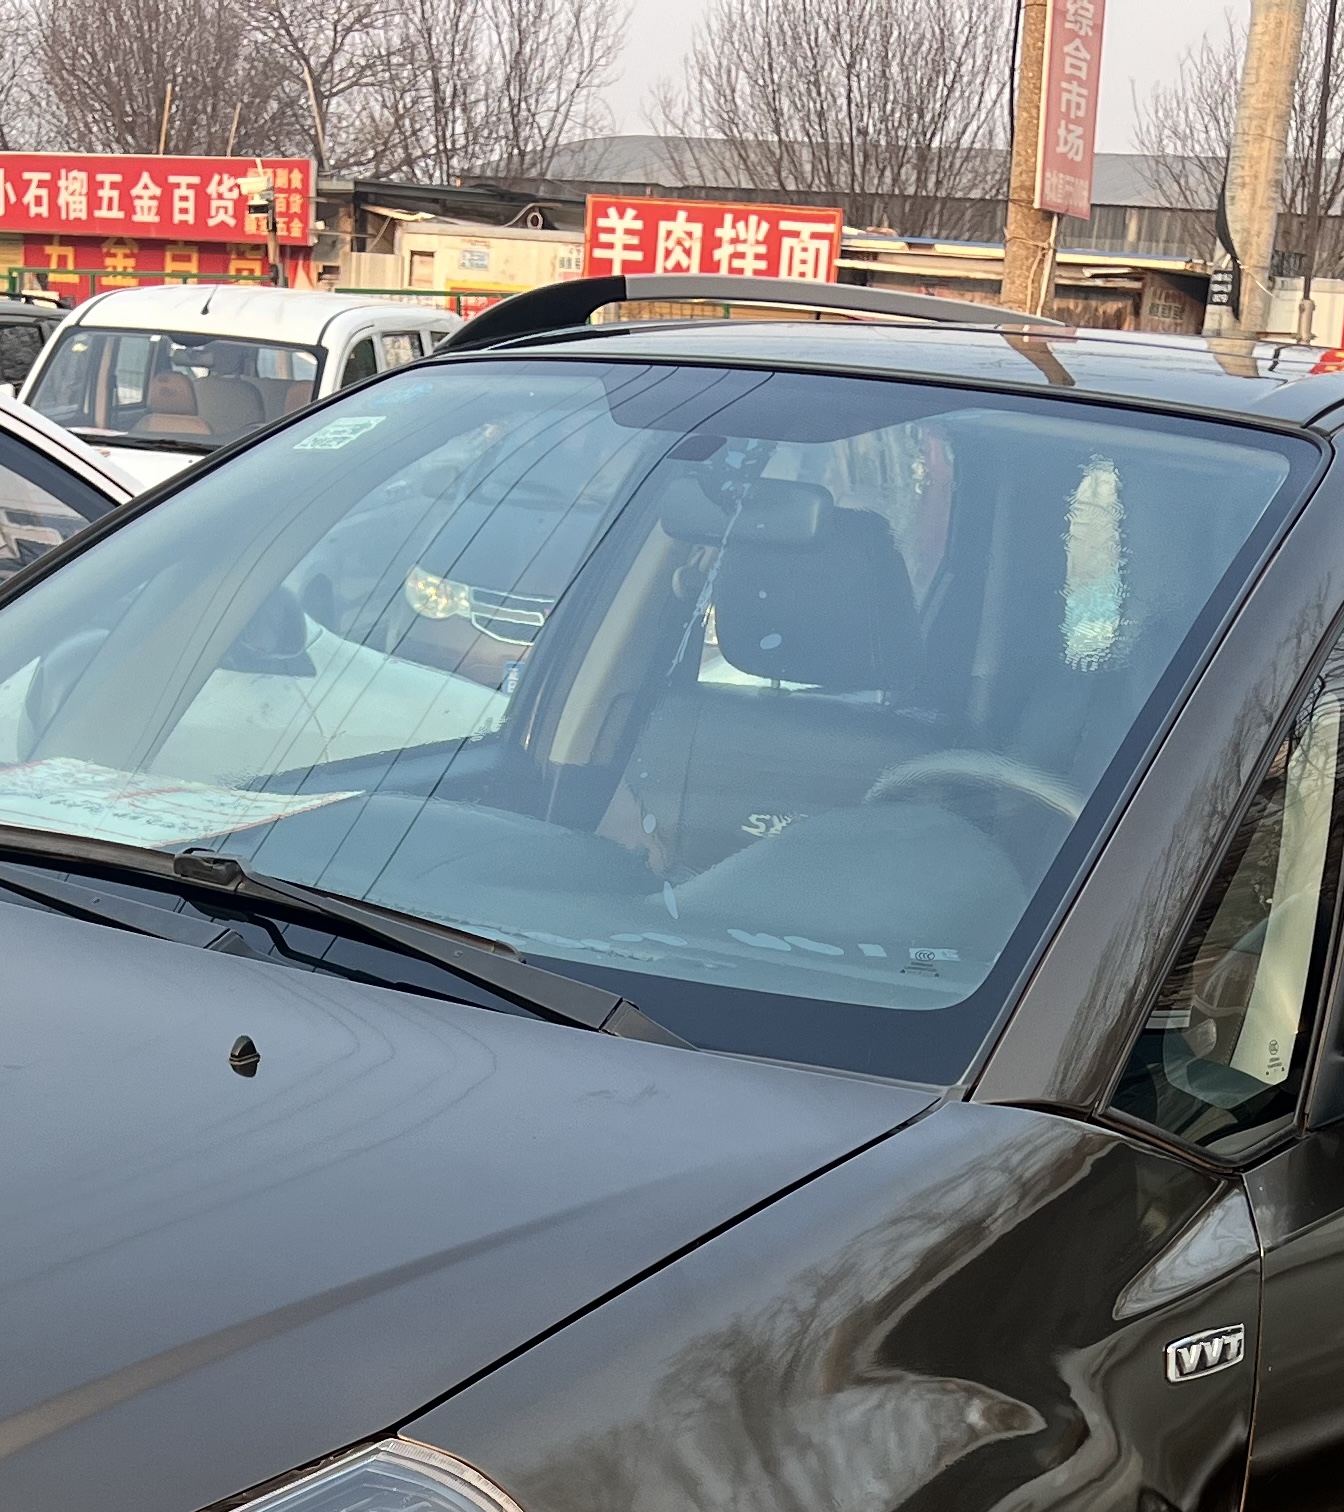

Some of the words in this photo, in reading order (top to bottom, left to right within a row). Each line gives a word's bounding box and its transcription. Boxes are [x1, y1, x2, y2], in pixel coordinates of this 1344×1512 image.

[1056, 0, 1095, 163] 综合市场
[591, 206, 837, 284] 羊肉拌面
[1176, 1332, 1243, 1375] VVT
